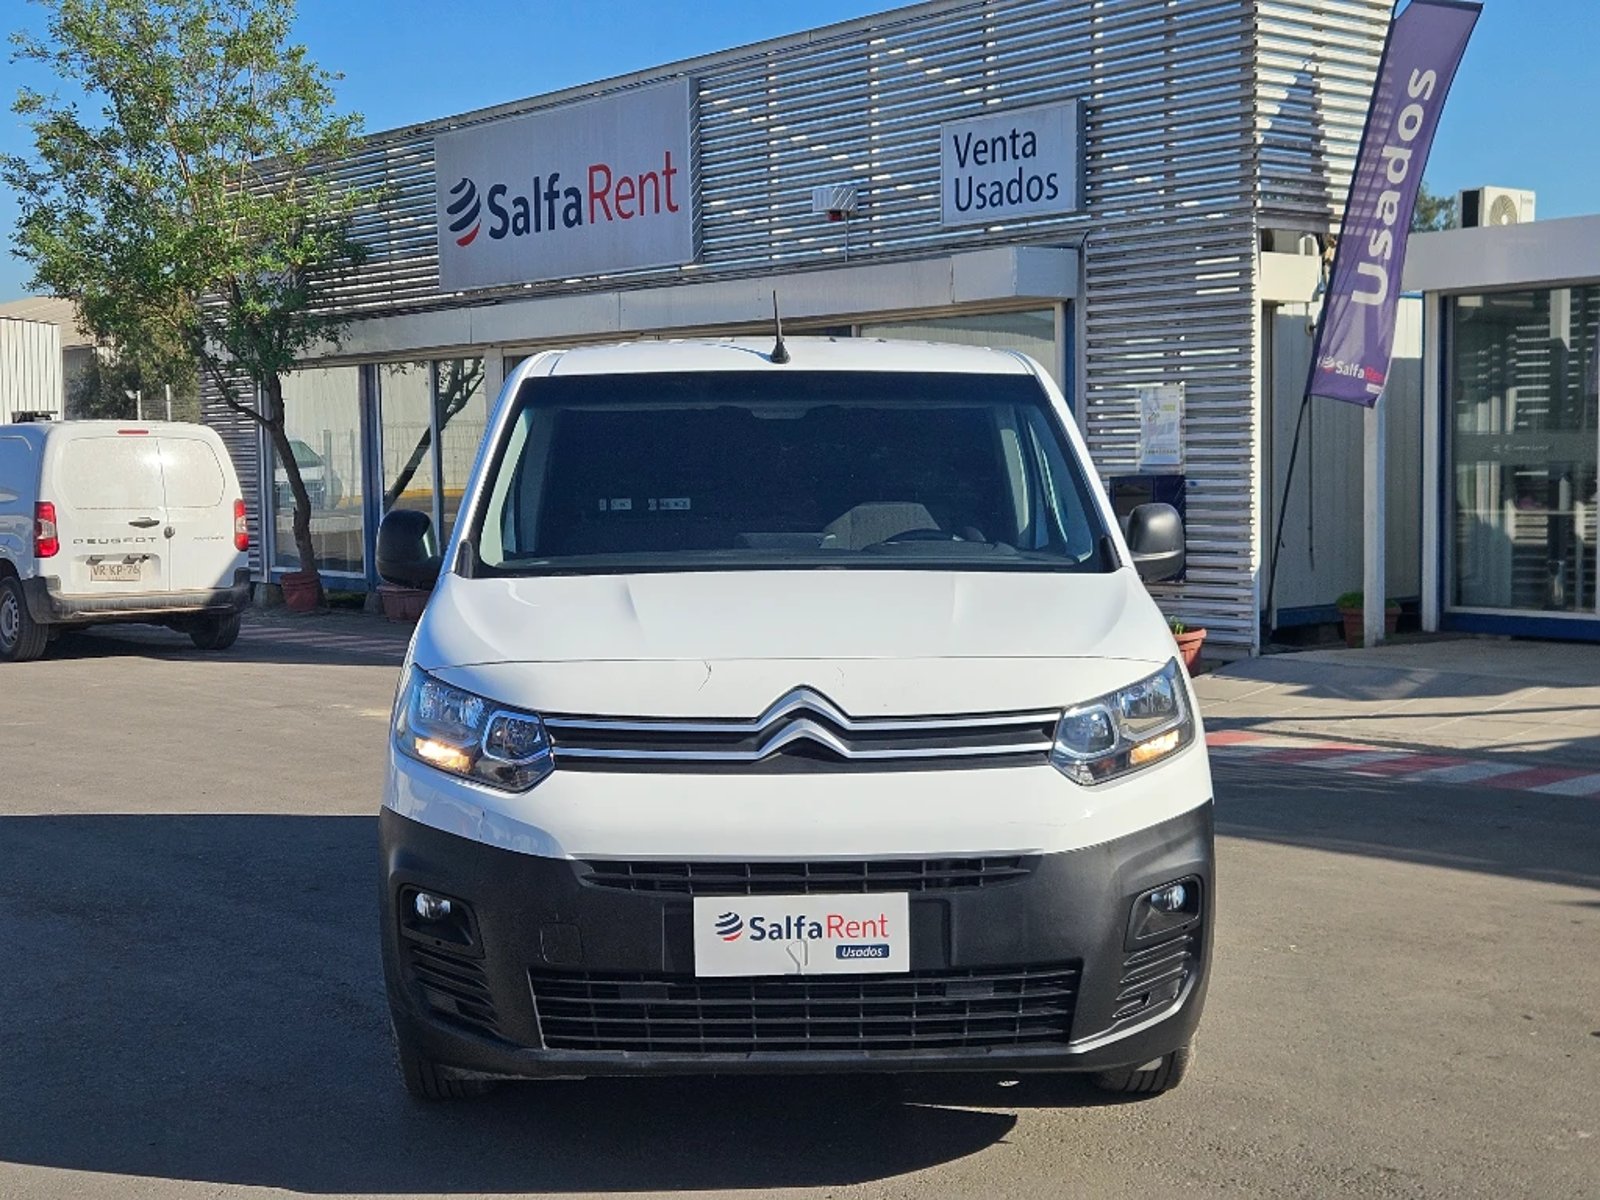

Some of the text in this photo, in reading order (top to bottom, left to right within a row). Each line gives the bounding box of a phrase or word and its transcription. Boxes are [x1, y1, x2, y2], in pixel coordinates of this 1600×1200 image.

[953, 128, 1037, 168] Venta
[487, 151, 679, 240] SalfaRent
[954, 166, 1059, 212] Usados
[1351, 67, 1437, 305] Usados
[749, 912, 891, 942] SalfaRent
[841, 945, 884, 958] Usados
